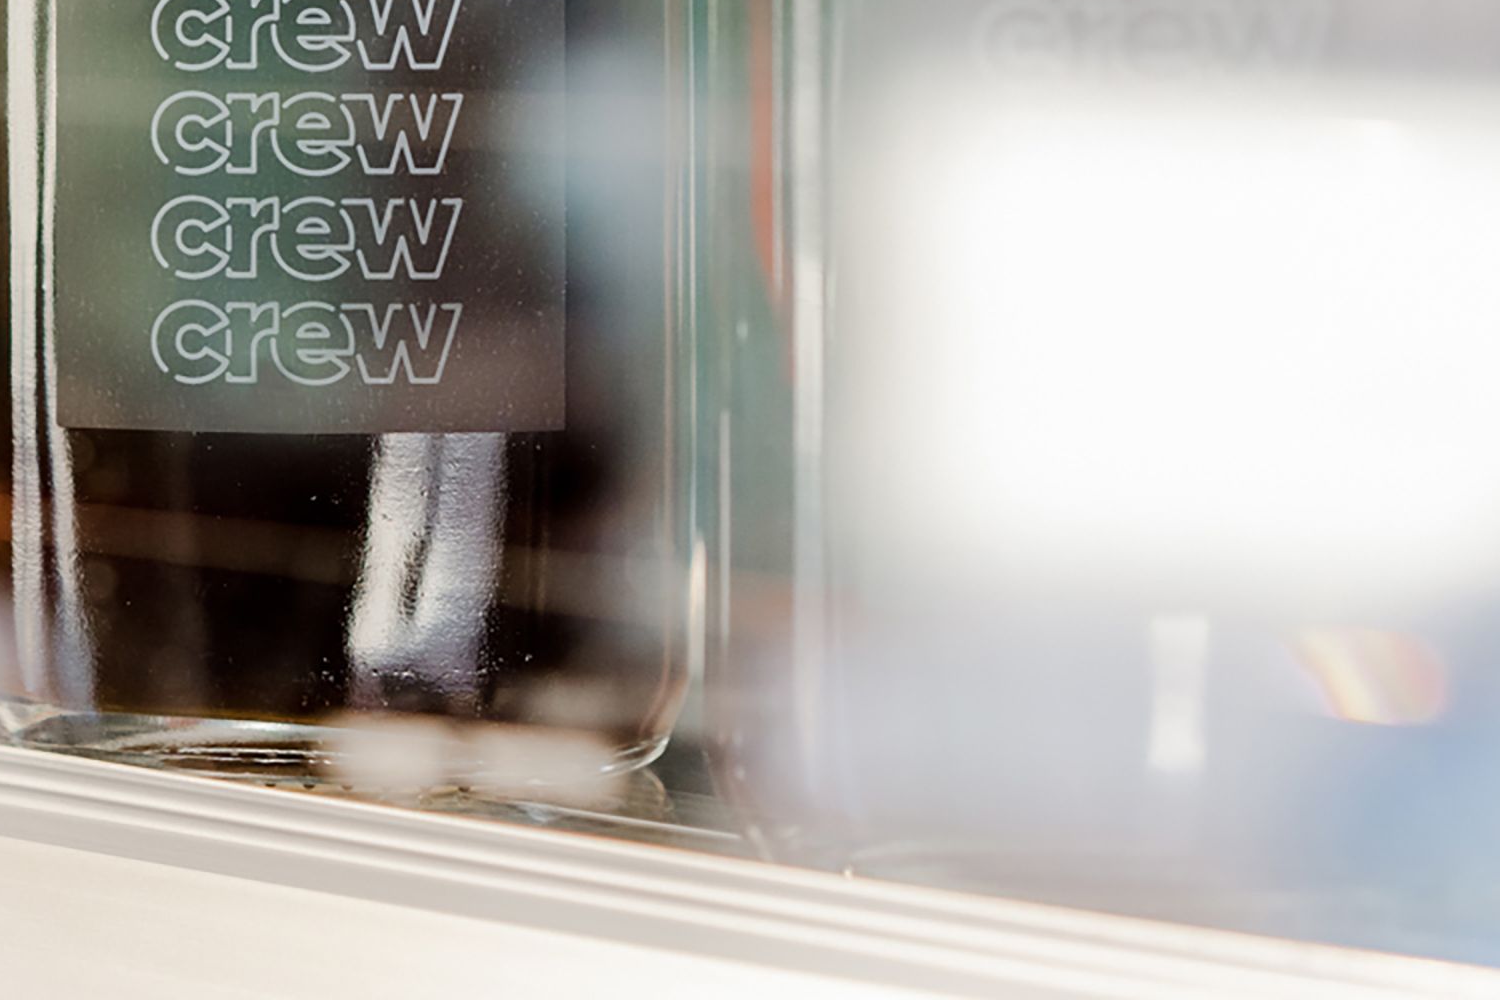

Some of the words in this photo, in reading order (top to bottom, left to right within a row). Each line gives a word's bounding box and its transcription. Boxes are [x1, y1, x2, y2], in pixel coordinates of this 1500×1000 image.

[150, 90, 464, 177] crew
[150, 195, 464, 281] crew
[150, 299, 464, 385] crew
